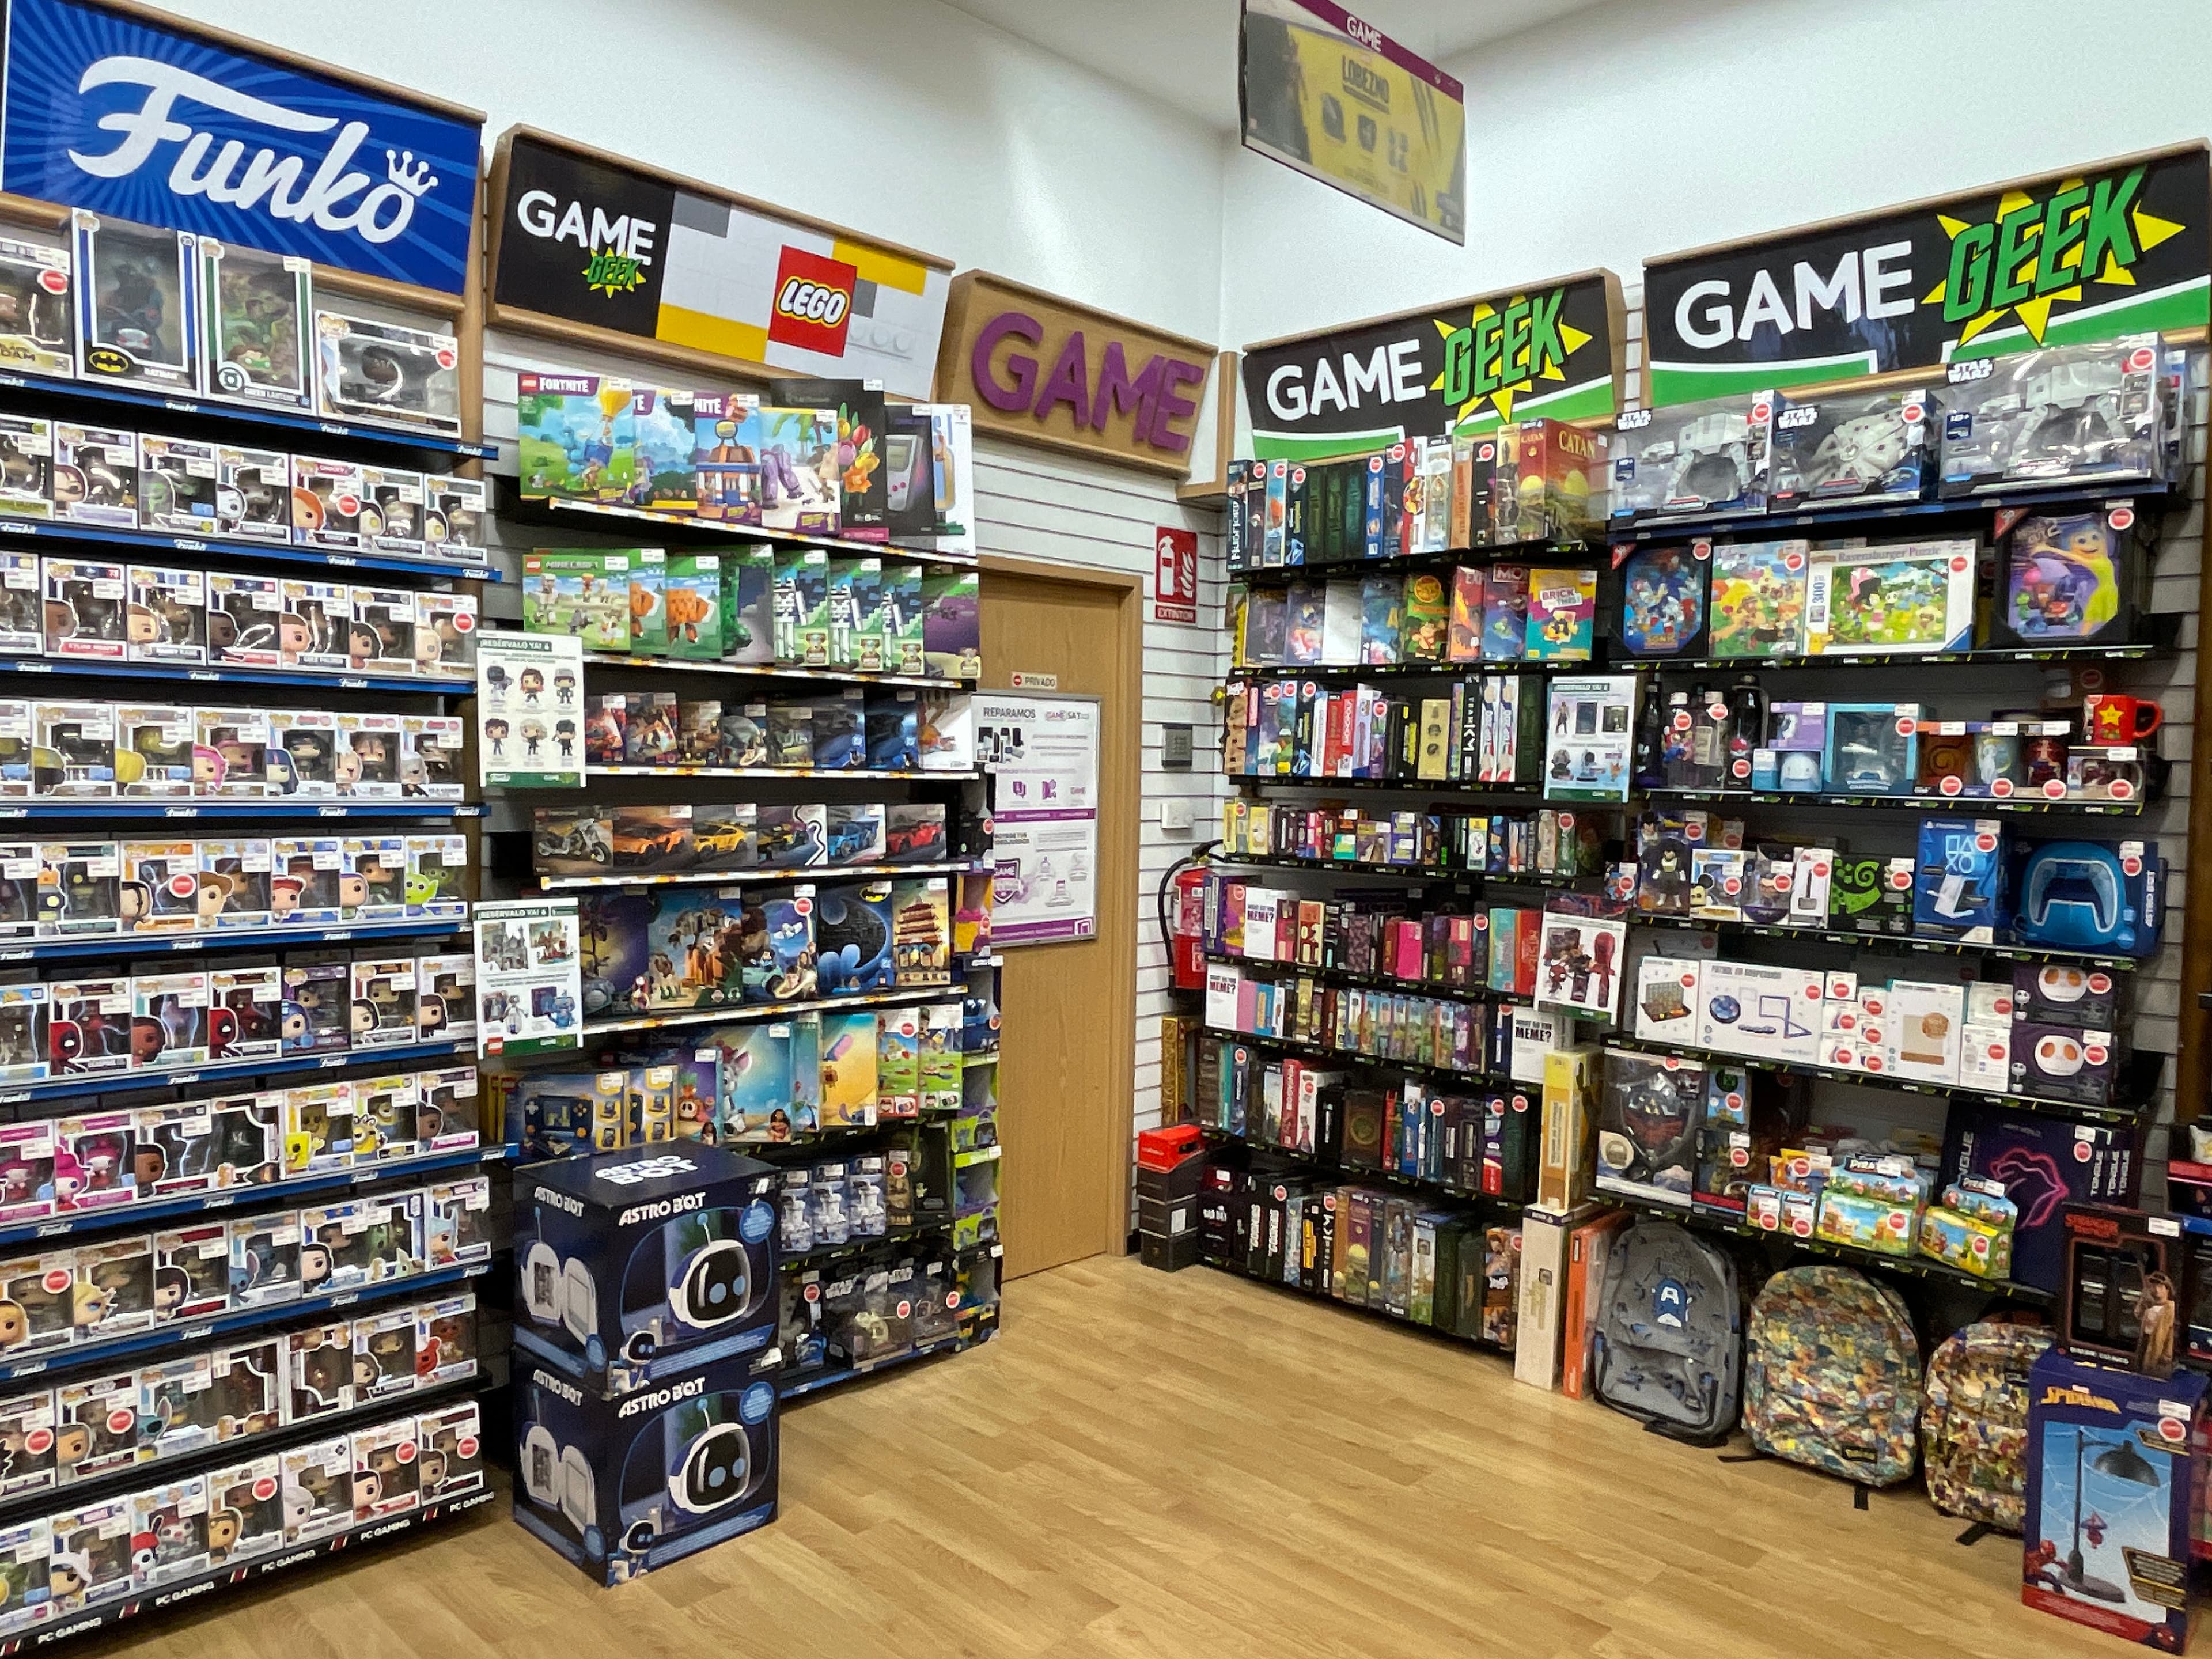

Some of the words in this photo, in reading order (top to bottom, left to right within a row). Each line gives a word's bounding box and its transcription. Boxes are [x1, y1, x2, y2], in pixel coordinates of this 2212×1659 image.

[1346, 17, 1382, 52] GAME
[1342, 55, 1390, 103] LOBEZNO
[67, 56, 417, 244] Funko
[517, 189, 656, 266] GAME
[1674, 240, 1915, 349] GAME
[1943, 165, 2147, 323] GEEK
[586, 254, 641, 287] GEEK
[778, 278, 849, 325] LEGO
[0, 347, 35, 362] DAM
[1266, 339, 1428, 421] GAME
[1444, 288, 1565, 407] GEEK
[1953, 359, 1994, 373] STAR
[539, 377, 589, 393] FORTNITE
[971, 311, 1205, 452] GAME
[1948, 368, 1993, 384] WARS
[694, 397, 722, 415] NITE
[1619, 410, 1652, 423] STAR
[1780, 405, 1819, 419] STAR
[1617, 418, 1652, 431] WARS
[1778, 415, 1819, 429] WARS
[1521, 433, 1544, 443] CATAN
[1558, 430, 1596, 459] CATAN
[1838, 547, 1906, 564] Ravensburger
[1908, 544, 1942, 559] Puzzle
[1541, 588, 1575, 601] BRICK
[1812, 579, 1825, 605] 300
[1025, 676, 1056, 687] PRIVADO
[983, 707, 1036, 719] REPARAMOS
[1209, 980, 1236, 995] MEME?
[1515, 1025, 1552, 1043] MEME?
[1959, 1131, 1975, 1177] NGUE
[595, 1156, 683, 1179] ASTRO
[611, 1158, 698, 1185] BOT
[2090, 1150, 2104, 1196] TONGUE
[2107, 1150, 2120, 1197] TONGUE
[534, 1185, 562, 1208] ASTRO
[563, 1196, 585, 1217] BOT
[619, 1199, 671, 1227] ASTRO
[672, 1192, 706, 1214] BOT
[533, 1369, 561, 1394] ASTRO
[562, 1383, 582, 1407] BOT
[618, 1392, 671, 1419] ASTRO
[672, 1377, 706, 1402] BOT
[450, 1502, 461, 1512] PC
[361, 1530, 374, 1541] PC
[374, 1518, 411, 1536] GAMING
[261, 1562, 275, 1573] PC
[276, 1549, 316, 1568] GAMING
[156, 1592, 171, 1606] PC
[171, 1581, 215, 1601] GAMING
[37, 1633, 54, 1645] PC
[56, 1617, 102, 1638] GAMING
